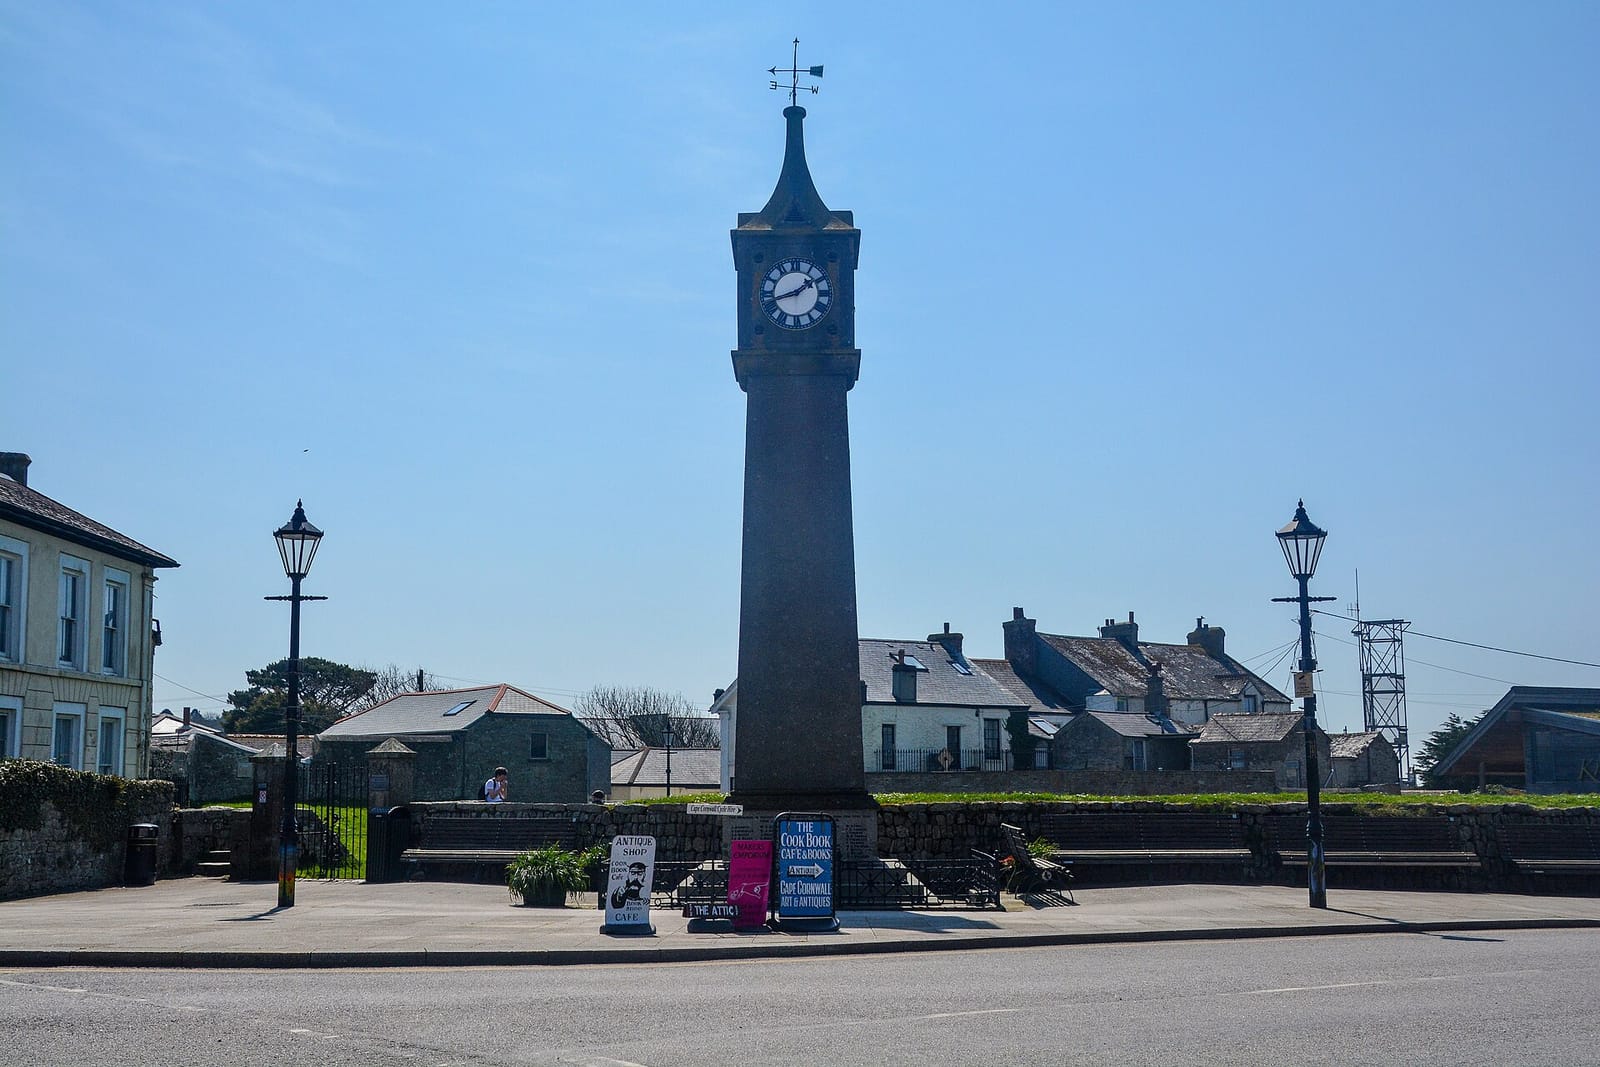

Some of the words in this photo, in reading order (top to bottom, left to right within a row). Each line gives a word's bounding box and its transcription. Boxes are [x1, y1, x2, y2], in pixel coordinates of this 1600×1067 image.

[690, 804, 701, 813] Cape
[701, 804, 717, 812] Cornwall
[797, 822, 813, 832] THE
[616, 837, 653, 846] ANTIQUE
[781, 833, 804, 847] COOK
[806, 833, 831, 847] BOOK
[780, 881, 796, 895] CAPE
[797, 881, 832, 895] CORNWALL
[781, 896, 792, 907] ART
[799, 896, 831, 908] ANTIQUES
[694, 905, 709, 915] THE
[711, 905, 734, 916] ATTIC
